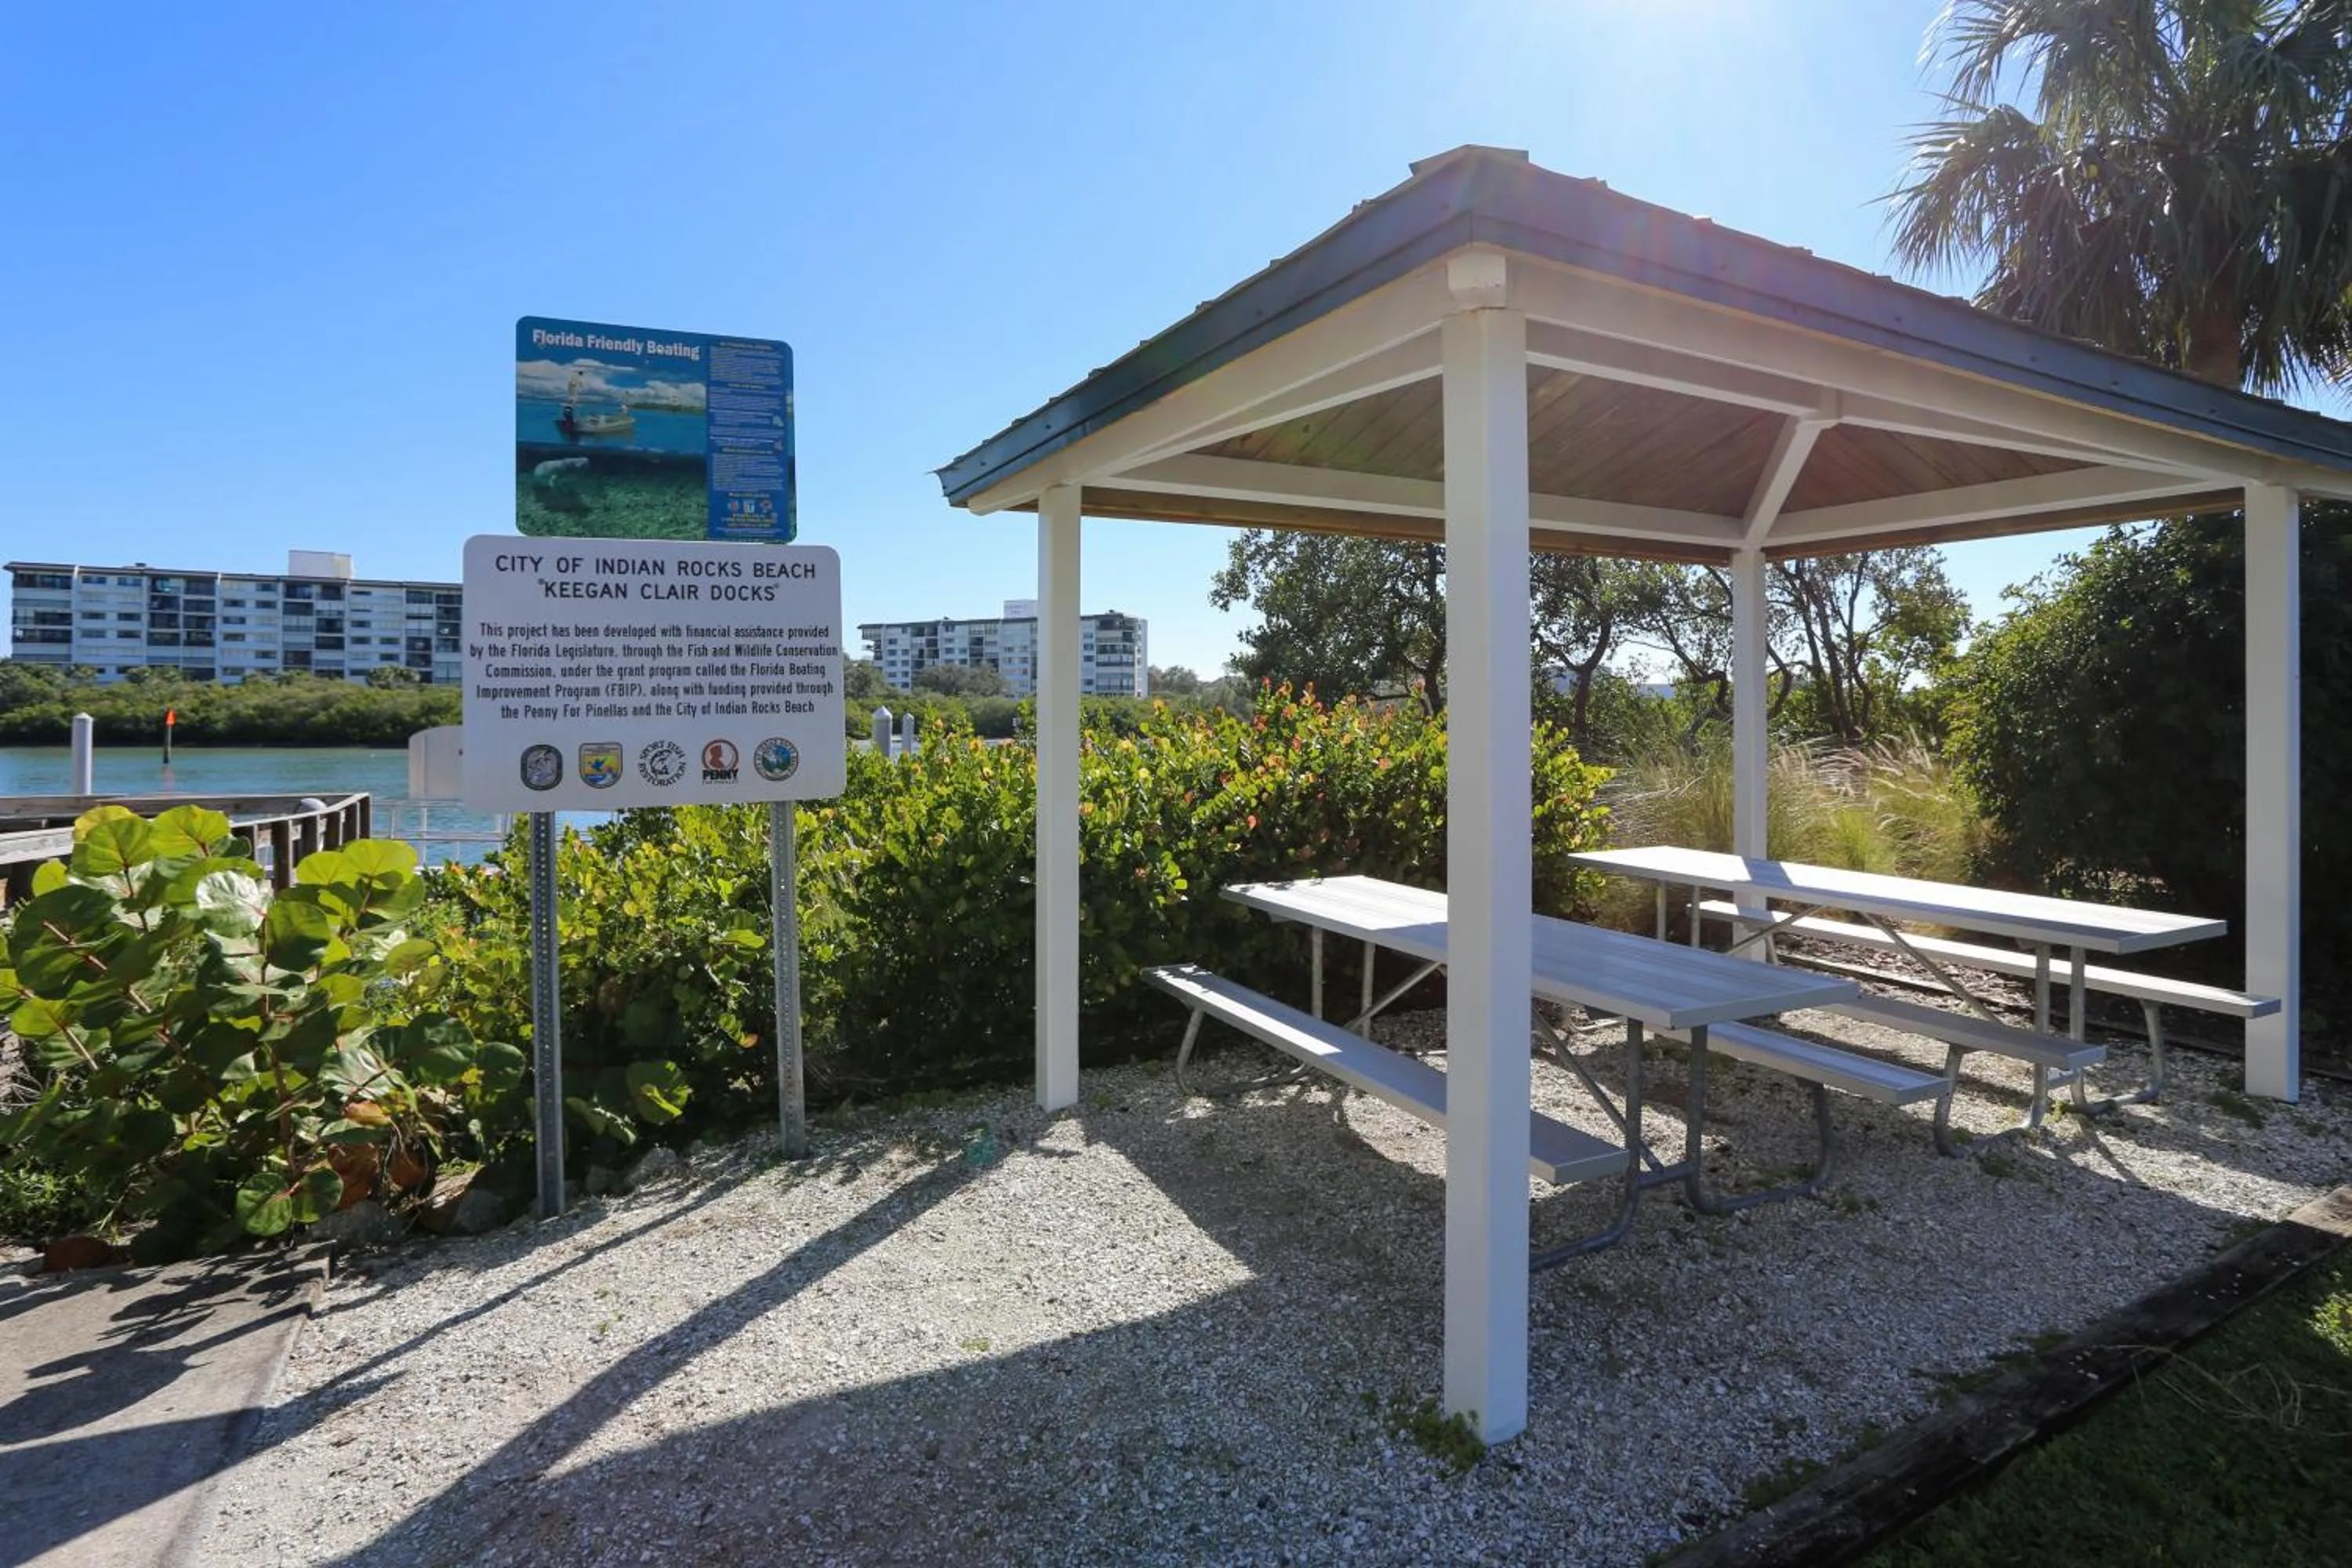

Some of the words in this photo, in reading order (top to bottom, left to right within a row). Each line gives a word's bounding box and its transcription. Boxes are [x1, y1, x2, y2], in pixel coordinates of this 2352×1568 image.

[532, 329, 583, 347] Florida
[587, 335, 643, 354] Friendly
[647, 340, 699, 361] Boating
[495, 555, 543, 572] CITY
[557, 557, 583, 573] OF
[596, 557, 665, 575] INDIAN
[677, 561, 742, 578] ROCKS
[753, 562, 815, 579] BEACH
[640, 582, 699, 601] CLAIR
[480, 622, 503, 636] This
[507, 624, 547, 640] project
[552, 625, 570, 637] has
[575, 625, 599, 637] been
[604, 624, 656, 641] developed
[661, 625, 681, 637] with
[687, 625, 730, 637] financial
[735, 626, 784, 637] assistance
[788, 626, 829, 640] provided
[470, 644, 483, 659] by
[488, 644, 506, 657] the
[512, 644, 550, 658] Florida
[622, 644, 662, 659] through
[666, 644, 683, 657] the
[688, 644, 707, 656] Fish
[713, 645, 730, 656] and
[735, 644, 771, 656] Wildlife
[776, 644, 837, 656] Conservation
[561, 666, 591, 677] under
[597, 665, 613, 677] the
[618, 665, 644, 680] grant
[649, 666, 691, 679] program
[695, 664, 726, 676] called
[731, 664, 746, 675] the
[750, 663, 784, 676] Florida
[789, 663, 826, 677] Boating
[477, 684, 550, 700] Improvement
[555, 684, 600, 699] Program
[651, 684, 678, 699] along
[684, 684, 704, 695] with
[709, 683, 746, 698] funding
[750, 682, 793, 696] provided
[796, 681, 833, 696] through
[502, 706, 519, 718] the
[524, 706, 557, 720] Penny
[564, 704, 580, 717] For
[586, 704, 627, 717] Pinellas
[633, 703, 652, 716] and
[656, 702, 672, 715] the
[677, 702, 696, 718] City
[702, 702, 711, 714] of
[716, 701, 746, 714] Indian
[753, 702, 780, 713] Rocks
[785, 701, 815, 713] Beach
[639, 740, 665, 759] SPORT
[667, 742, 685, 759] FISH
[639, 761, 687, 786] RESTORATION
[702, 769, 739, 779] PENNY
